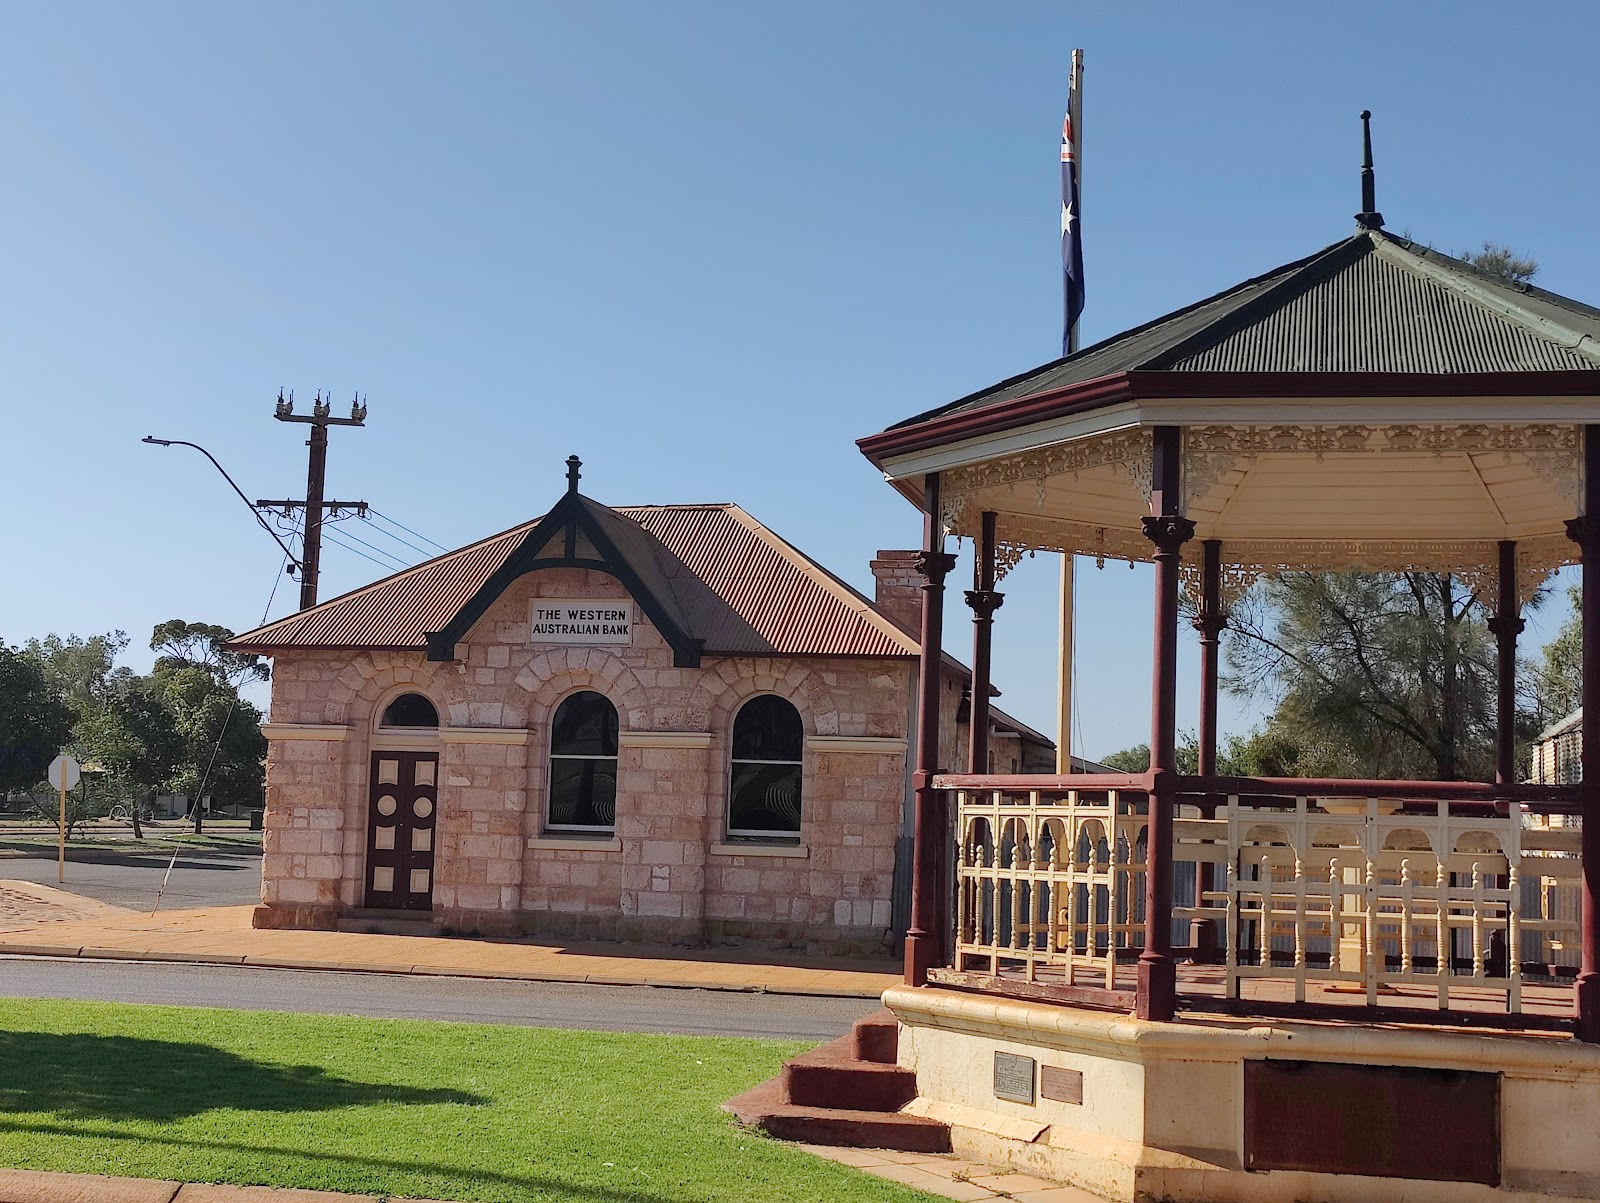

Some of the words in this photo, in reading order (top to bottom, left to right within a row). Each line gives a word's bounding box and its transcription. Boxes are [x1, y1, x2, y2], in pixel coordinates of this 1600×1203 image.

[537, 610, 561, 620] THE
[568, 610, 626, 620] WESTERN
[532, 624, 599, 635] AUSTRALIAN
[602, 624, 629, 635] BANK
